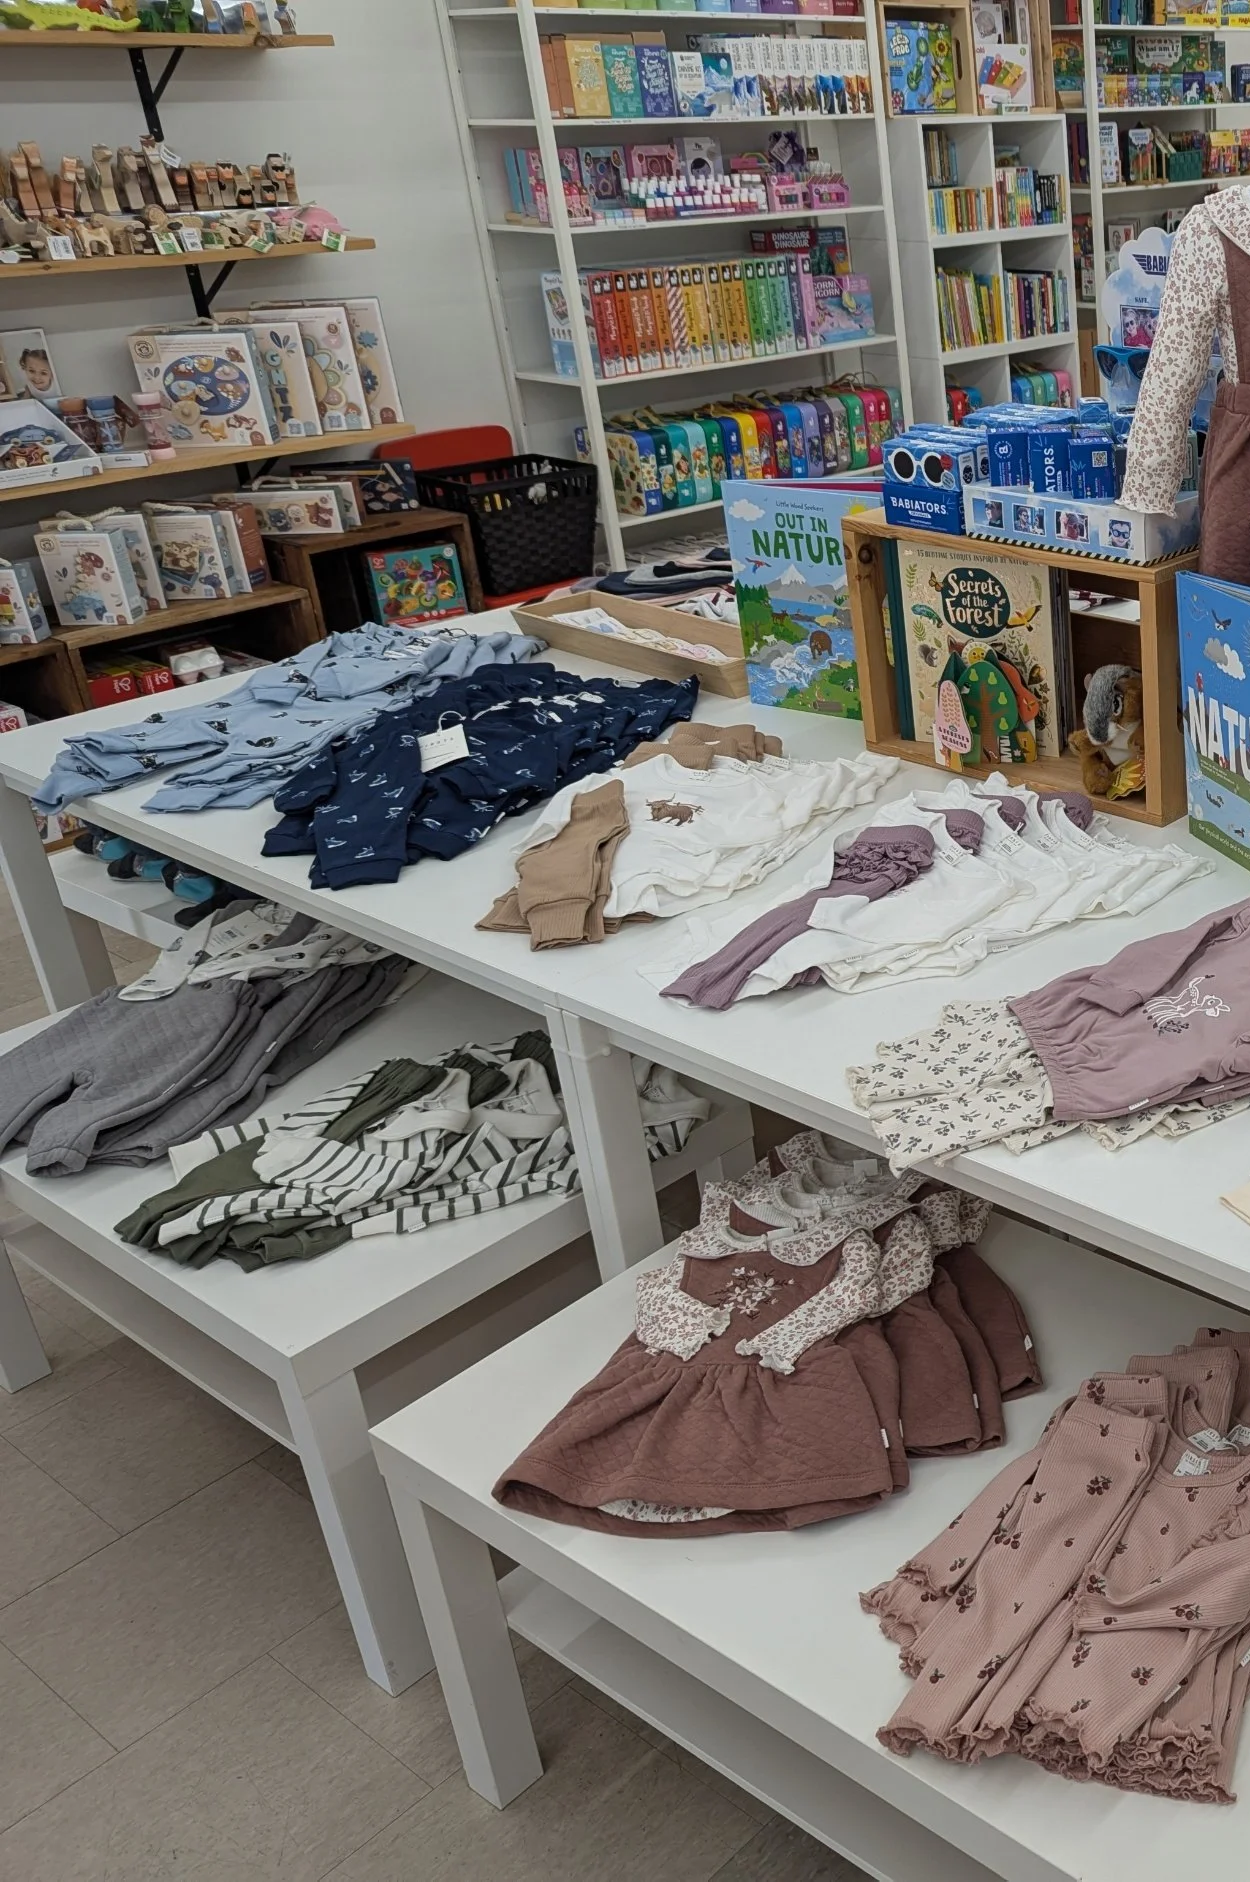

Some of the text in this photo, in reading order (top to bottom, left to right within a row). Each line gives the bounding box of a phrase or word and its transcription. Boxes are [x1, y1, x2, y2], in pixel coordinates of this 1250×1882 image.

[774, 240, 810, 249] DINOSAUR
[1046, 447, 1056, 492] ATORS
[890, 496, 948, 515] BABIATORS
[774, 512, 828, 533] OUT IN
[751, 529, 843, 566] NATUR
[948, 572, 1002, 598] Secrets
[961, 595, 989, 607] of the
[944, 597, 1004, 629] Forest
